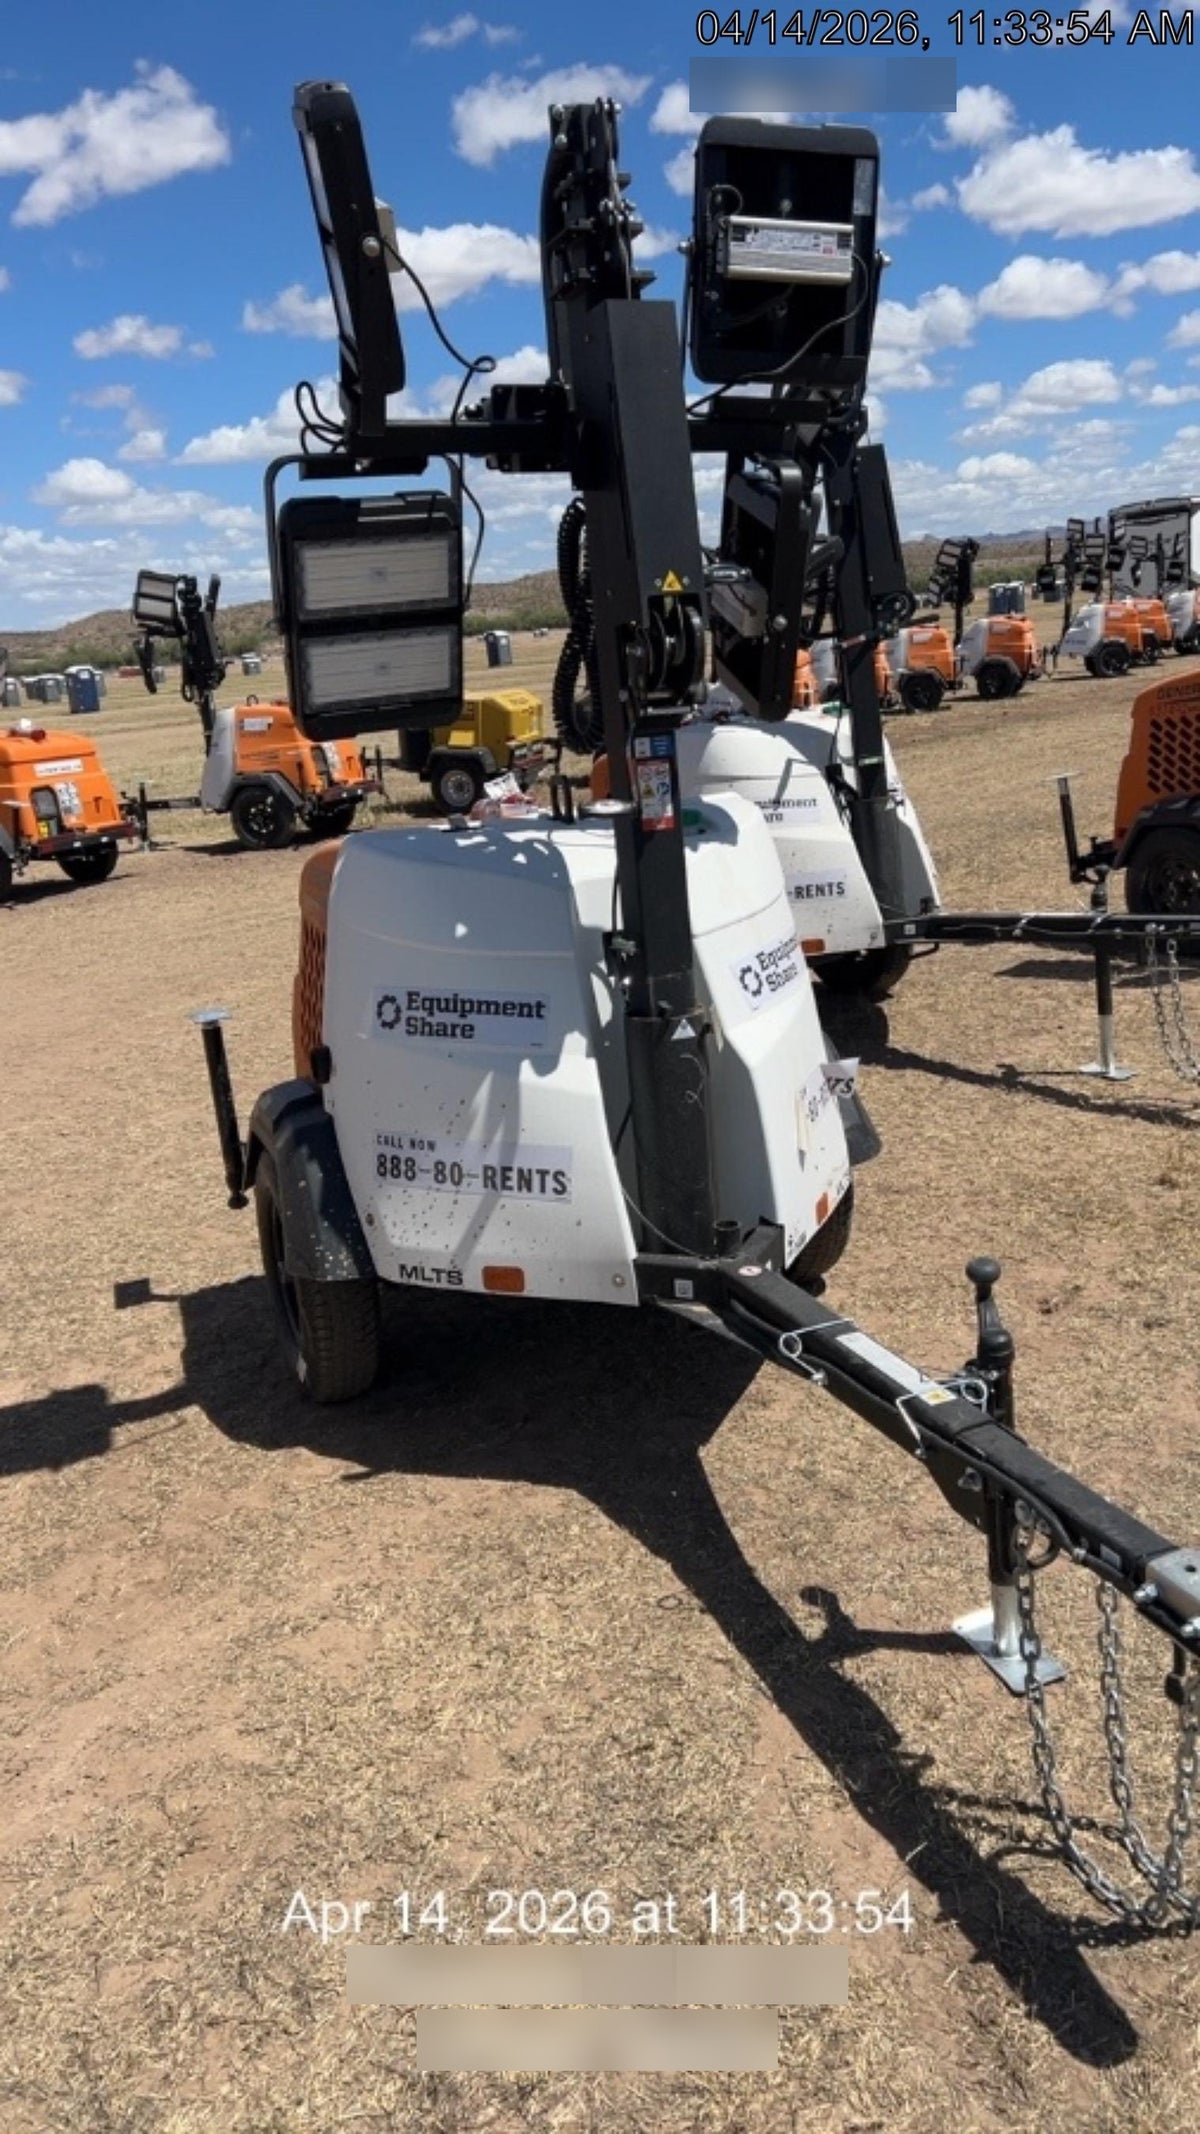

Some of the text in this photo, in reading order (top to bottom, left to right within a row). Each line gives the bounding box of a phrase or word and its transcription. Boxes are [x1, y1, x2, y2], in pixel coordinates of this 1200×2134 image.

[406, 991, 546, 1019] Equipment
[405, 1016, 475, 1039] Share
[376, 1134, 437, 1152] CALL NOW
[376, 1153, 568, 1195] 888-80-RENTS
[399, 1263, 463, 1286] MLTS
